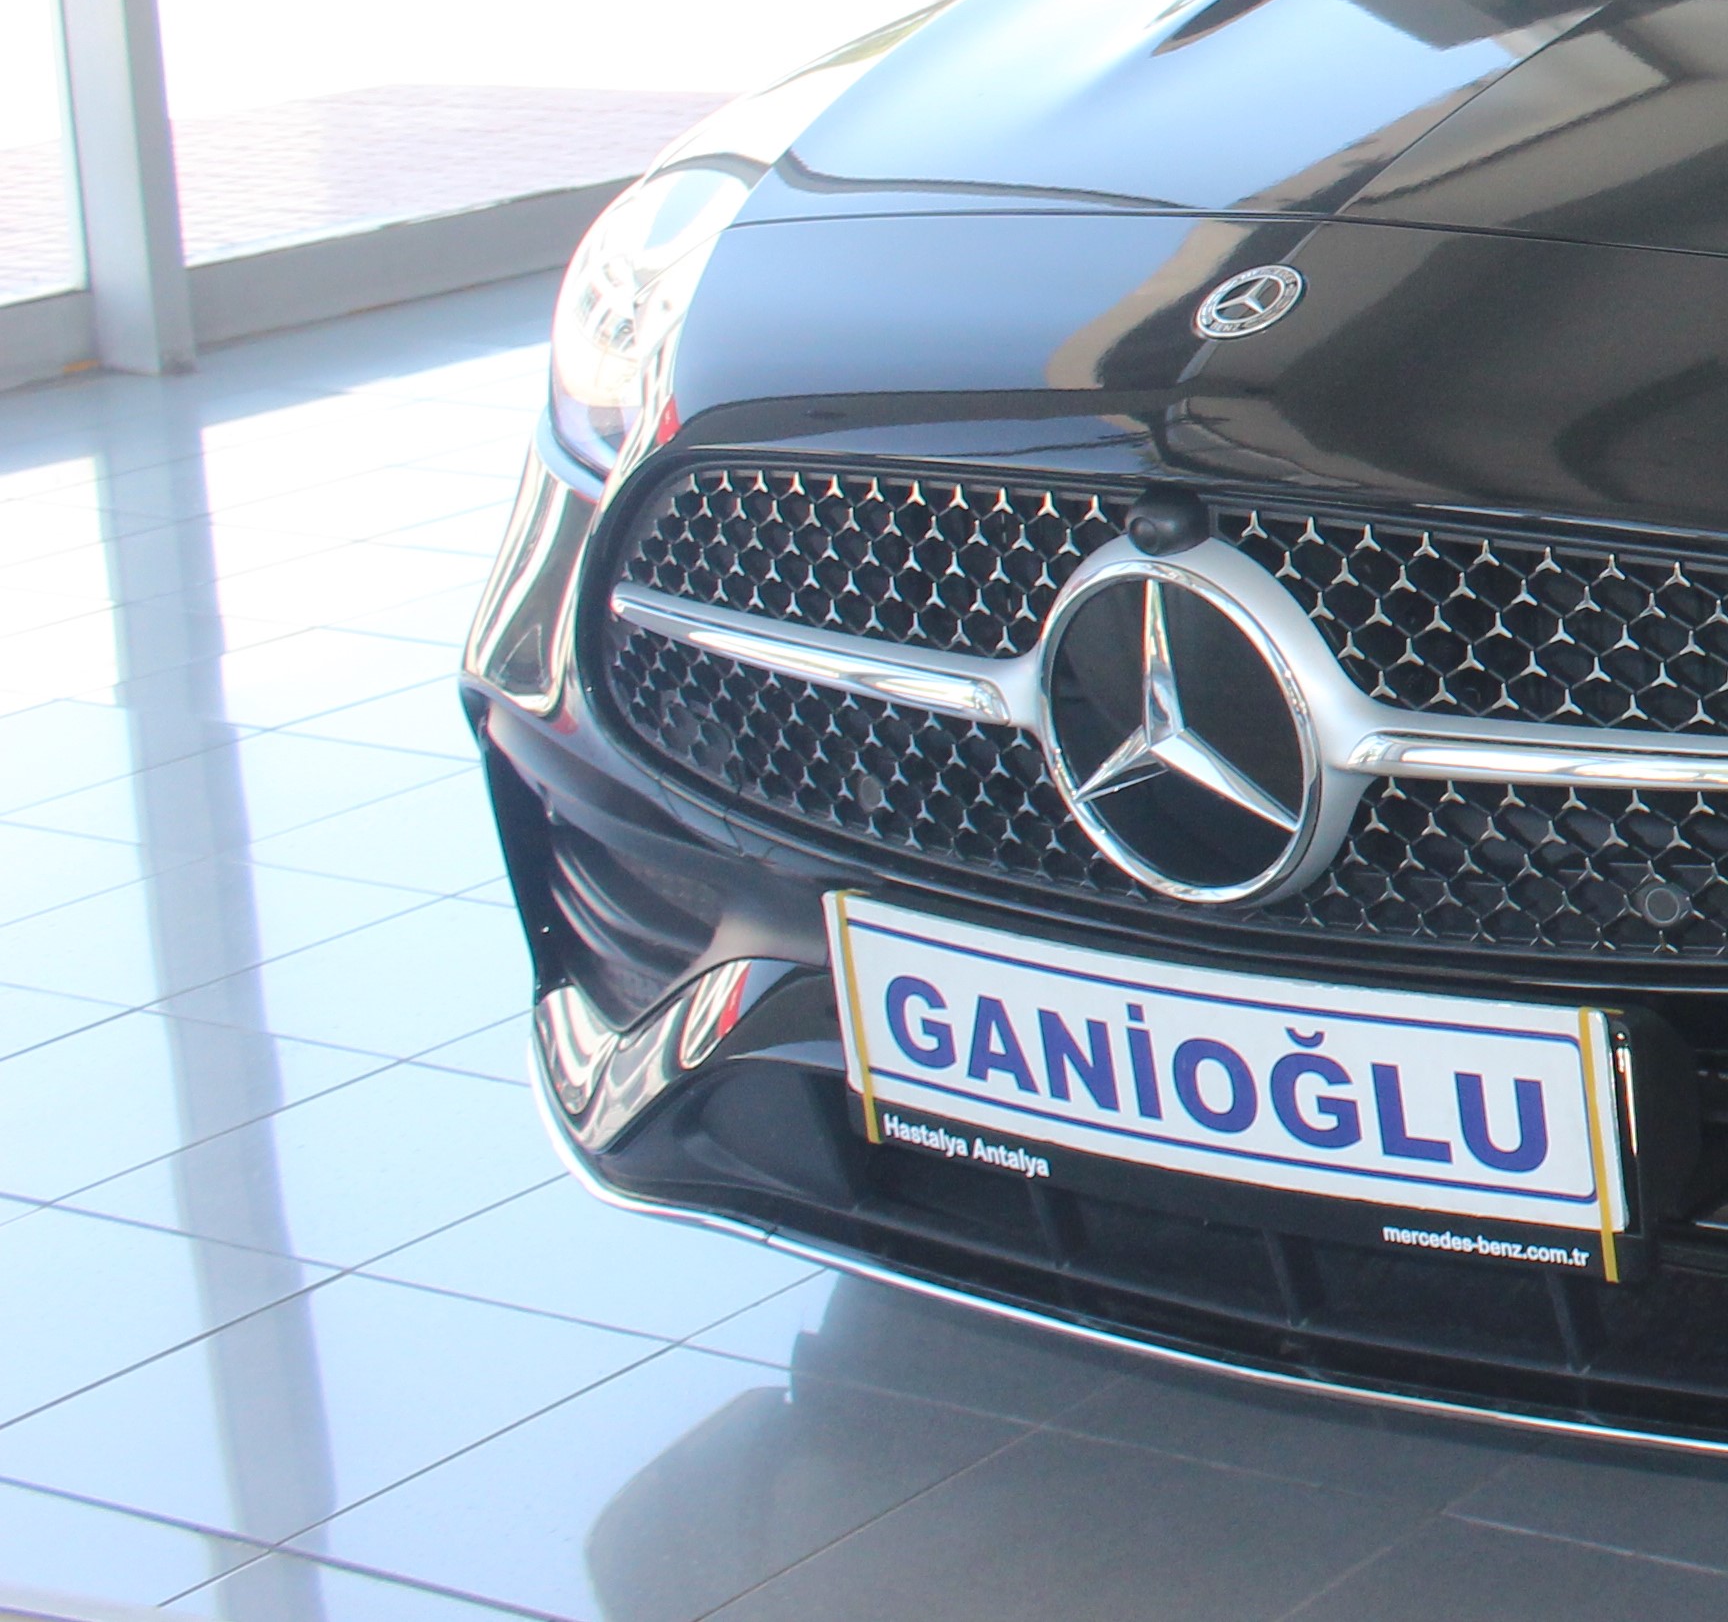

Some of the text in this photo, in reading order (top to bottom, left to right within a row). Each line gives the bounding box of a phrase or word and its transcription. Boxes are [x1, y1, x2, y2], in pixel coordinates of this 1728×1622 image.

[884, 975, 1549, 1175] GANİOĞLU
[883, 1112, 1050, 1178] Hastalya Antalya
[1382, 1226, 1590, 1268] mercedes-benz.com.tr
